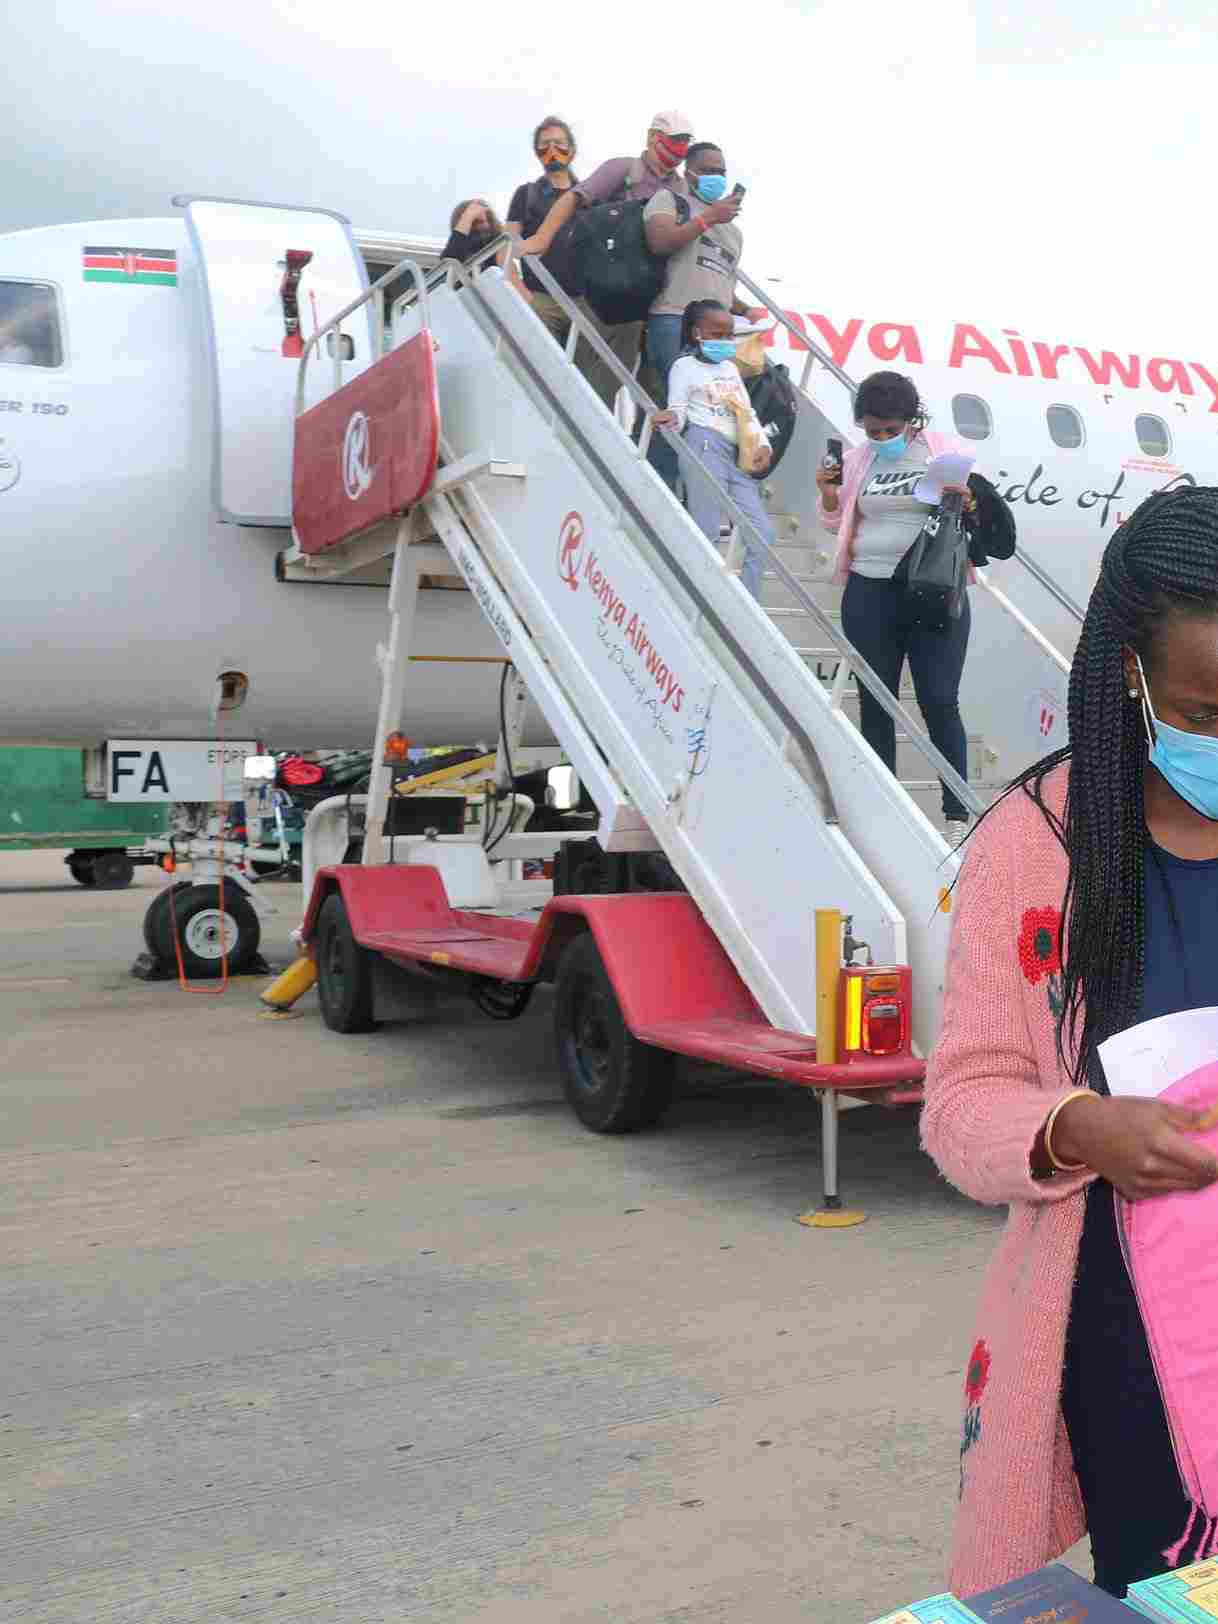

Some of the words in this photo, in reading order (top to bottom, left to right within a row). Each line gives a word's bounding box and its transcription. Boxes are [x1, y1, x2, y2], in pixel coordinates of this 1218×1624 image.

[760, 309, 924, 368] nya
[1077, 471, 1125, 528] of
[583, 552, 627, 627] Kenya
[624, 613, 686, 713] Airways
[112, 751, 169, 793] FA
